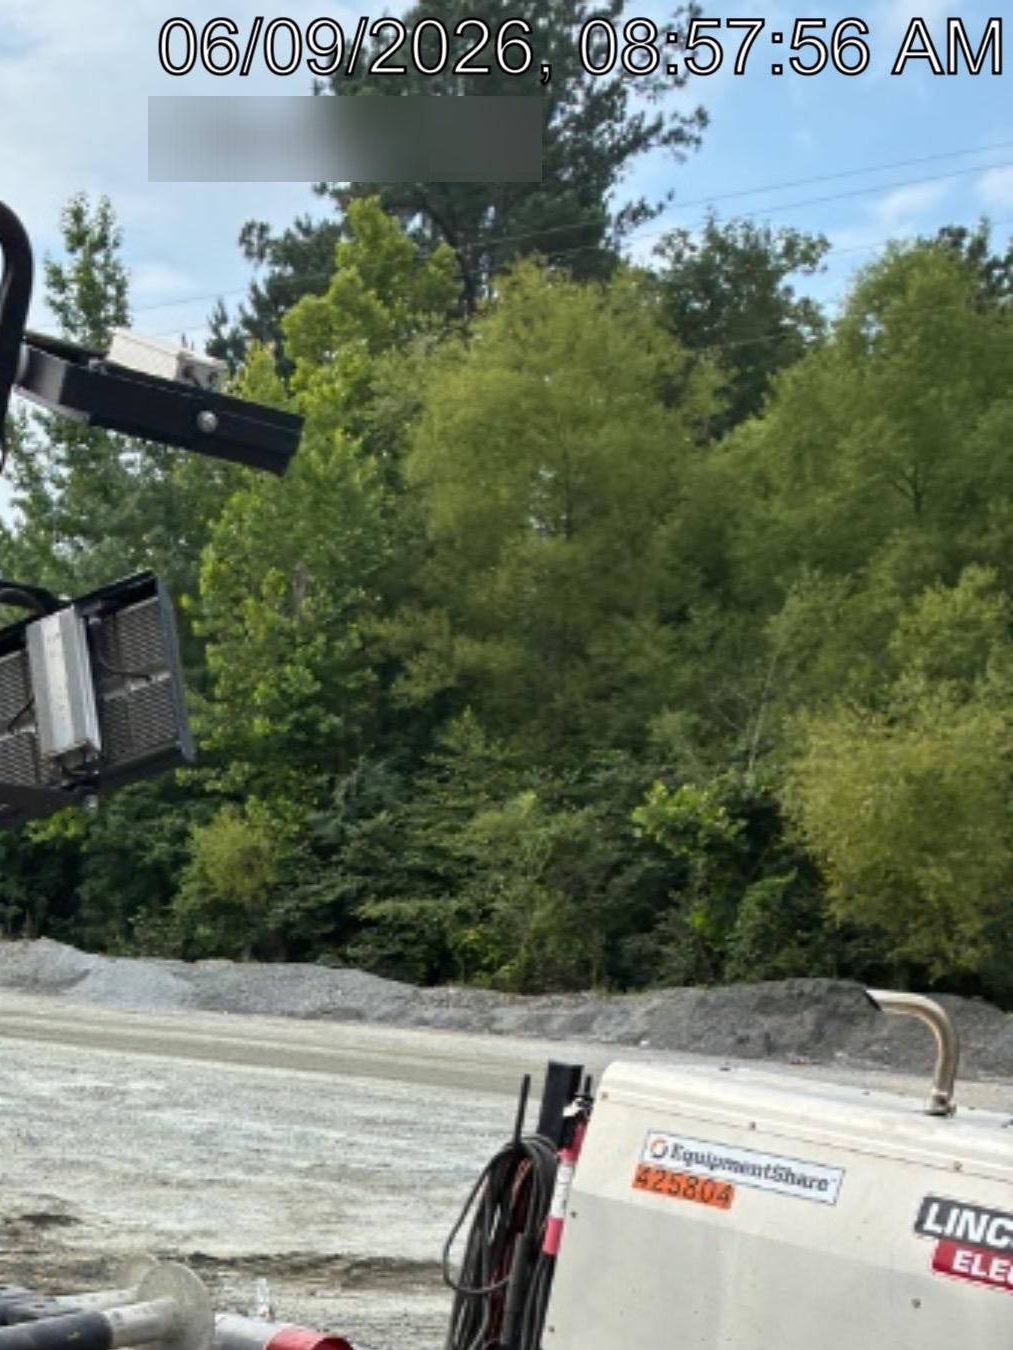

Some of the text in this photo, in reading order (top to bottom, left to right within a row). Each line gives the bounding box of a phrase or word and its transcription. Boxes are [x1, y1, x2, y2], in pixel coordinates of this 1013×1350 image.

[635, 1167, 734, 1205] 425804
[671, 1143, 828, 1192] EquipmentShare
[922, 1202, 1013, 1249] LINC
